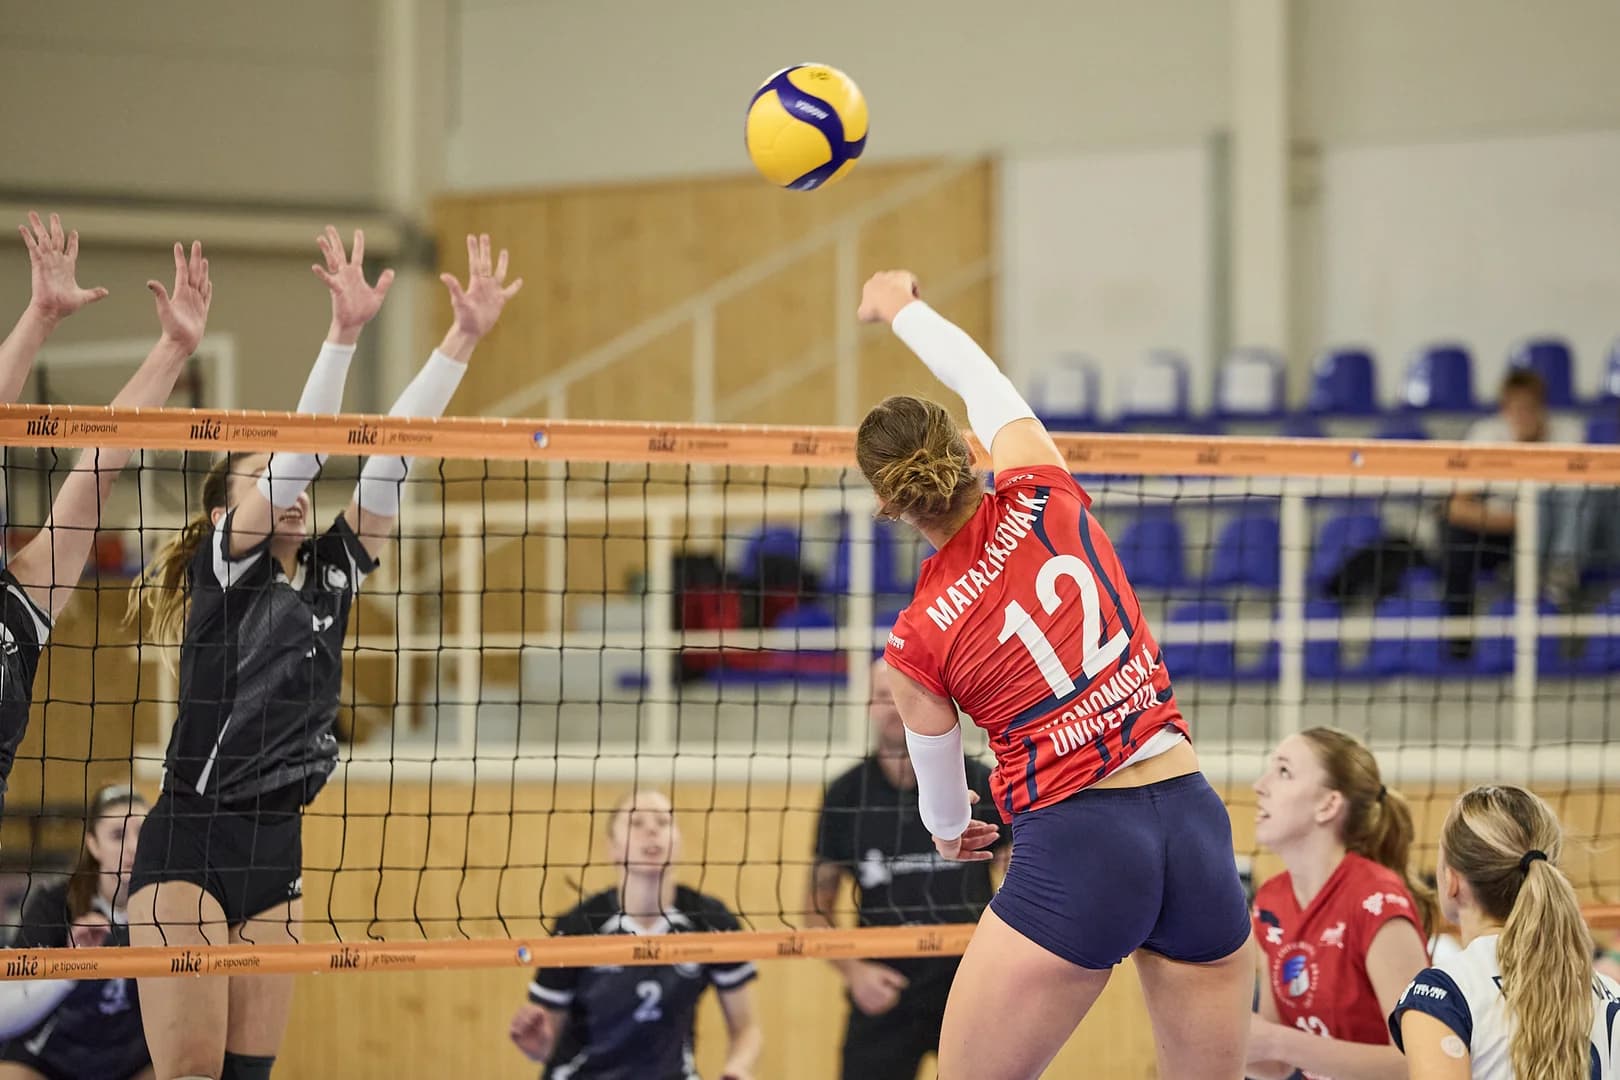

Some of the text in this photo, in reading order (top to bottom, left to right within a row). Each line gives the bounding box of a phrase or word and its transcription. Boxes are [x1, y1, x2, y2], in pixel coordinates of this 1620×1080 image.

[27, 414, 118, 436] niké je tipovanie
[190, 418, 221, 440] niké
[241, 426, 278, 438] tipovanie
[347, 423, 378, 445] niké
[997, 554, 1130, 699] 12
[6, 954, 38, 976] niké
[60, 959, 98, 971] tipovanie
[171, 951, 202, 973] niké
[329, 947, 360, 969] niké
[633, 980, 662, 1022] 2
